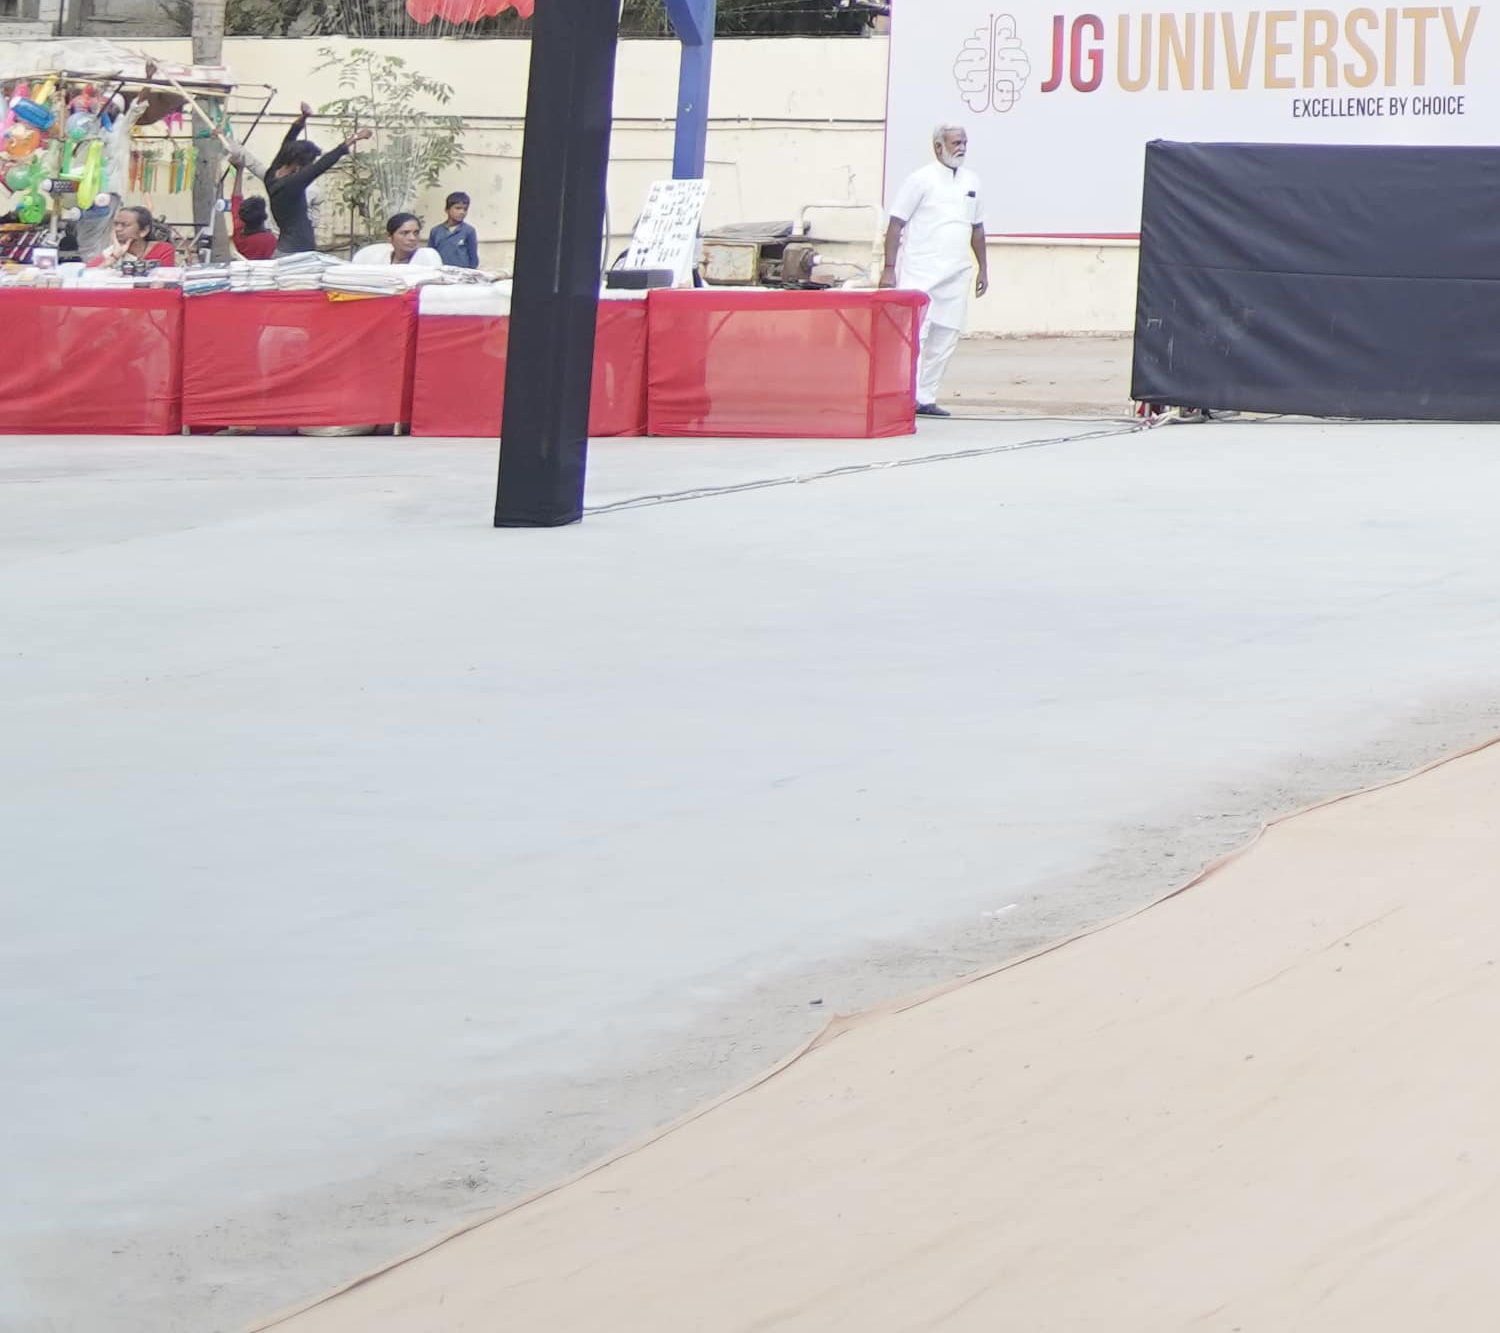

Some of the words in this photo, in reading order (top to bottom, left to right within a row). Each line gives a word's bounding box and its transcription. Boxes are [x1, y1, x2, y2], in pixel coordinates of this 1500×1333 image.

[1040, 13, 1105, 93] JG
[1117, 5, 1481, 93] UNIVERSITY
[1293, 97, 1384, 118] EXCELLENCE
[1389, 96, 1408, 116] BY
[1412, 95, 1465, 116] CHOICE
